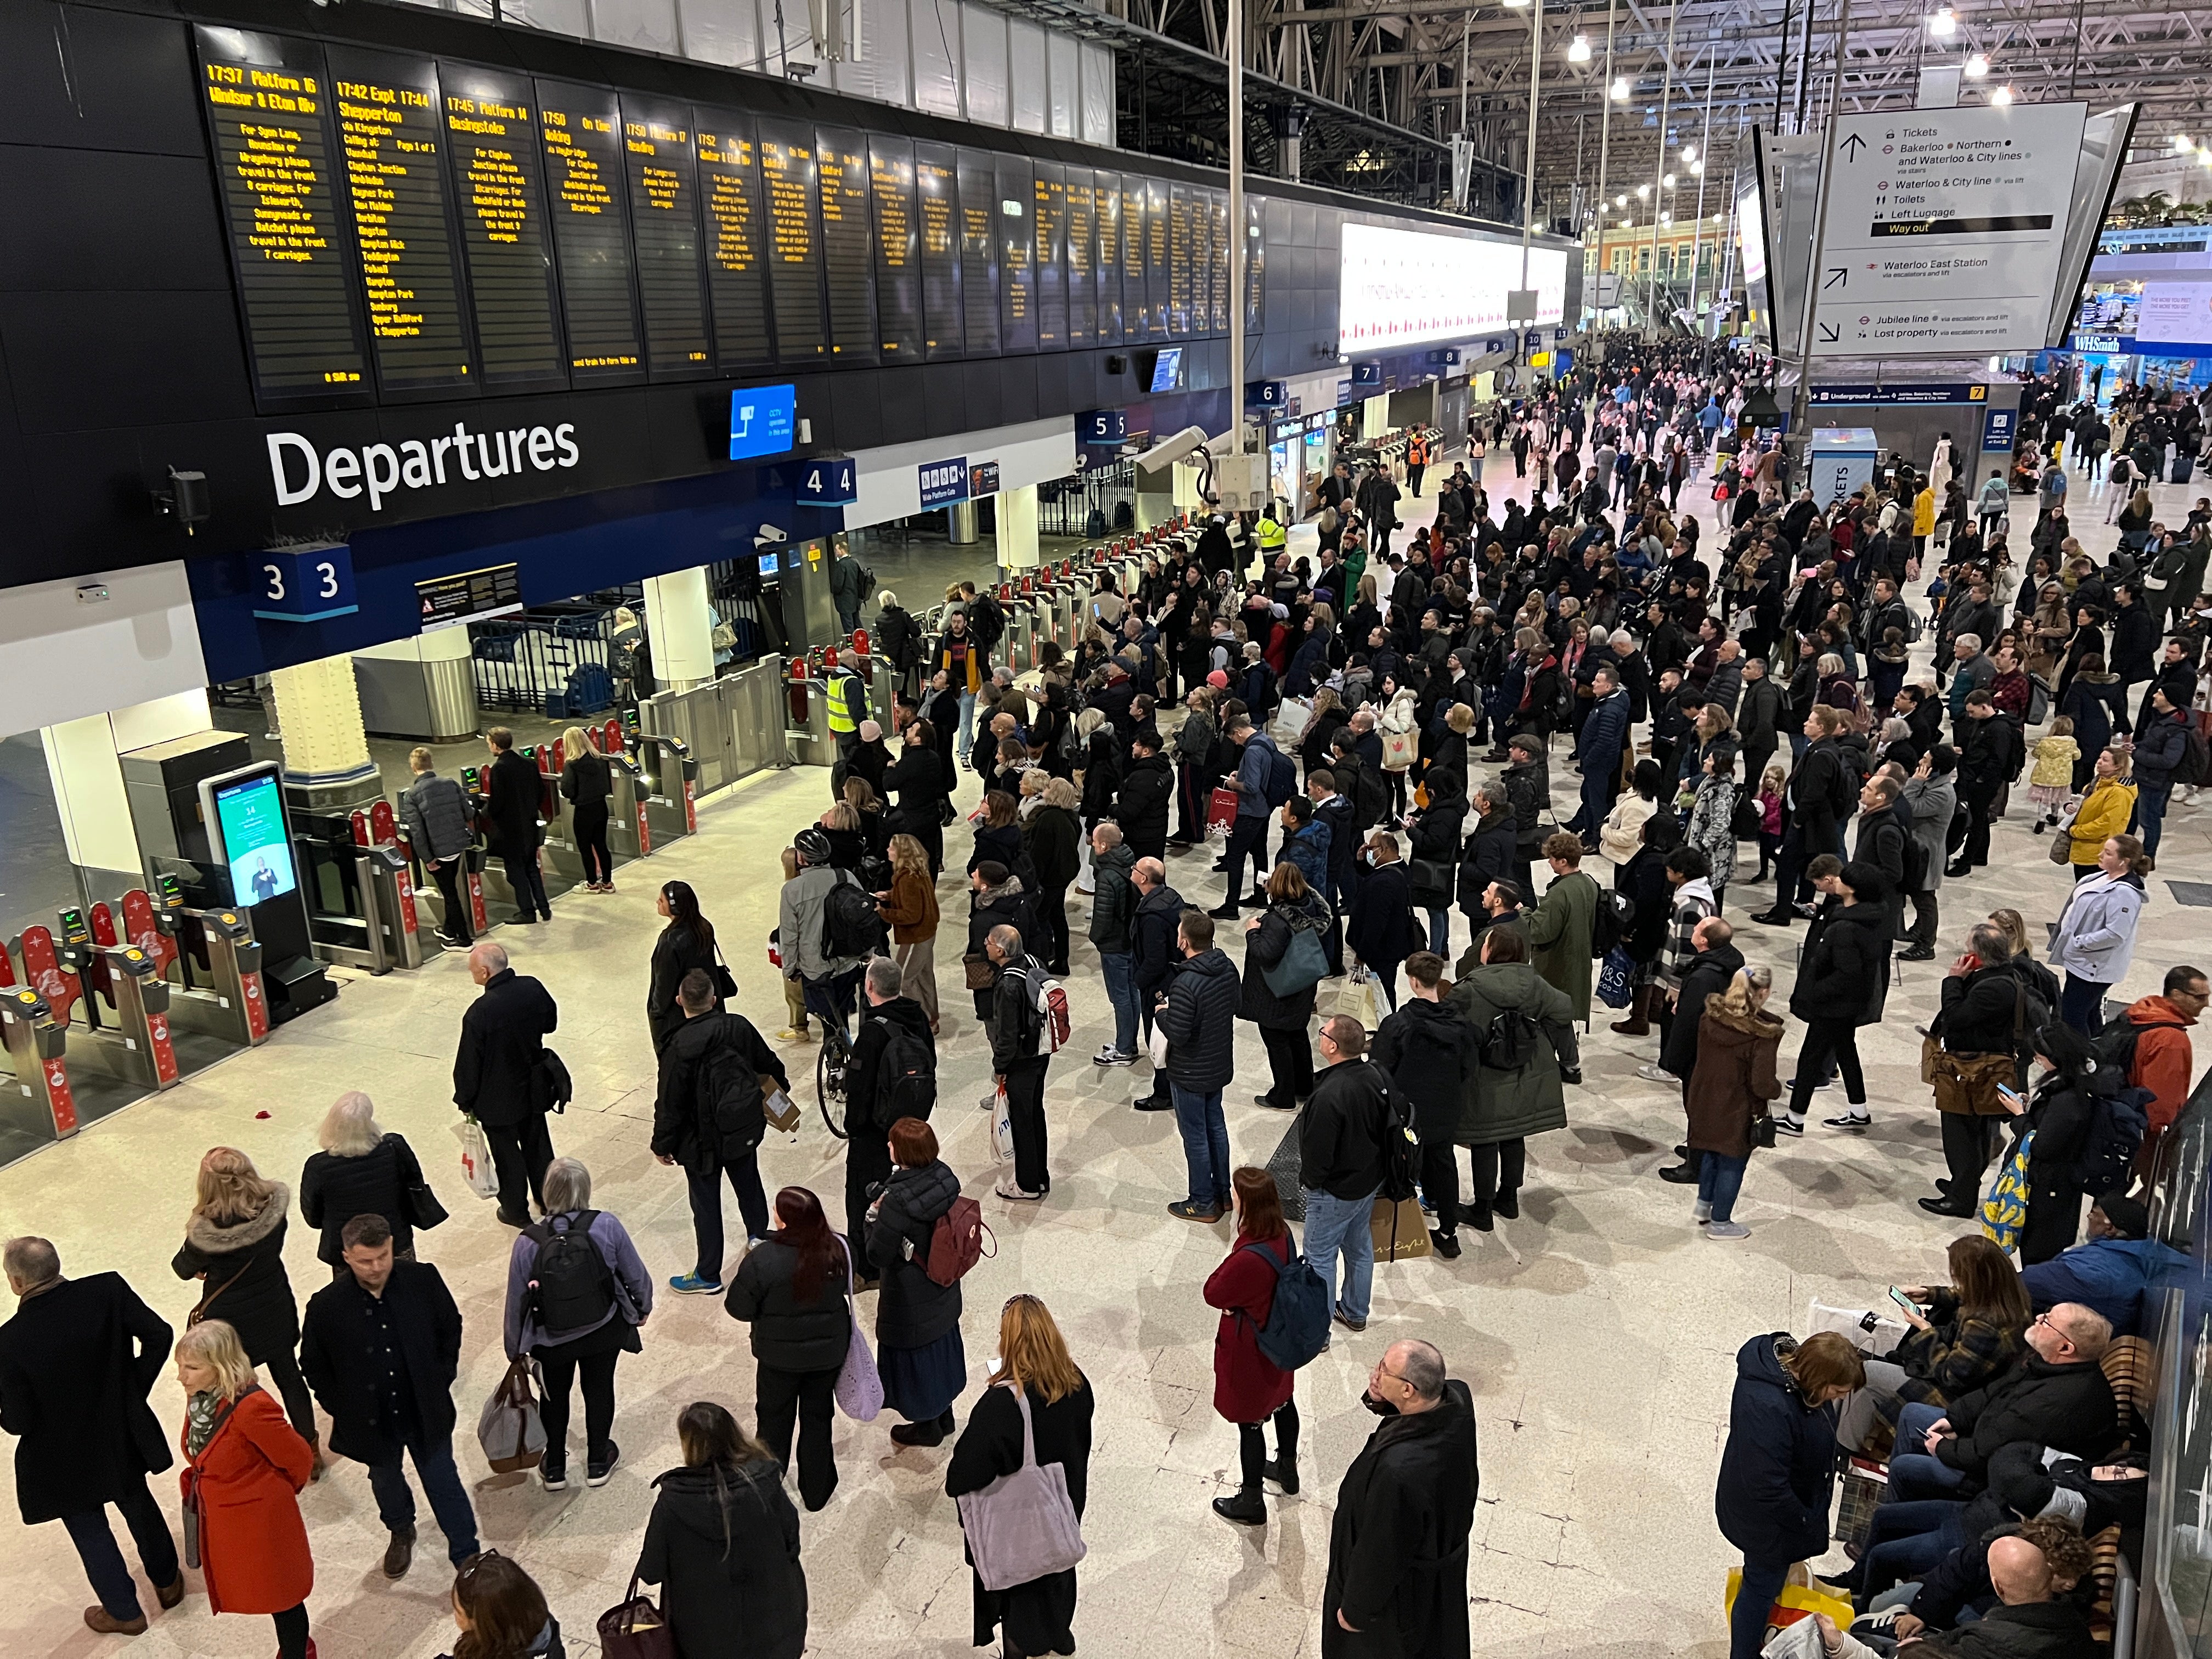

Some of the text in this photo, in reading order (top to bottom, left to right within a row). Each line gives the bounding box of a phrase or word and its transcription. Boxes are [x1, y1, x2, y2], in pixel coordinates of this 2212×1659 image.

[207, 65, 316, 93] 17:37 Platform 16
[209, 87, 315, 113] Windsor & Eton Riv
[337, 82, 431, 109] 17:42 Expt 17:44
[338, 101, 402, 123] Shepperton
[448, 97, 527, 120] 17:45 Platform 14
[449, 116, 505, 135] Basingstoke
[582, 117, 593, 130] On
[545, 129, 571, 145] Woking
[1903, 128, 1938, 137] Tickets
[397, 140, 414, 151] Page
[415, 142, 420, 151] 1
[421, 143, 429, 152] of
[431, 144, 435, 153] 1
[627, 139, 654, 155] Reading
[1900, 141, 2001, 153] Bakerloo Northern
[1898, 157, 1917, 166] and
[1920, 156, 1964, 164] Waterloo
[1977, 153, 1996, 163] City
[1999, 152, 2022, 161] lines
[1895, 180, 1940, 189] Waterloo
[1953, 178, 1972, 188] City
[1974, 177, 1991, 185] line
[1894, 195, 1926, 204] Toilets
[1891, 209, 1955, 219] Left Luggage
[1889, 224, 1929, 234] Way out
[1884, 261, 1927, 270] Waterloo
[1954, 259, 1988, 267] Station
[1897, 329, 1938, 338] property
[1493, 343, 1499, 352] 9
[2075, 336, 2119, 352] WHSmith
[1446, 352, 1453, 362] 8
[1362, 368, 1370, 379] 7
[1263, 386, 1272, 400] 6
[1974, 388, 1982, 397] 7
[1097, 417, 1107, 435] 5
[1120, 416, 1124, 434] 5
[266, 422, 579, 511] Departures
[808, 470, 822, 493] 4
[840, 468, 850, 491] 4
[263, 565, 285, 600] 3
[317, 562, 338, 598] 3
[246, 805, 256, 816] 14
